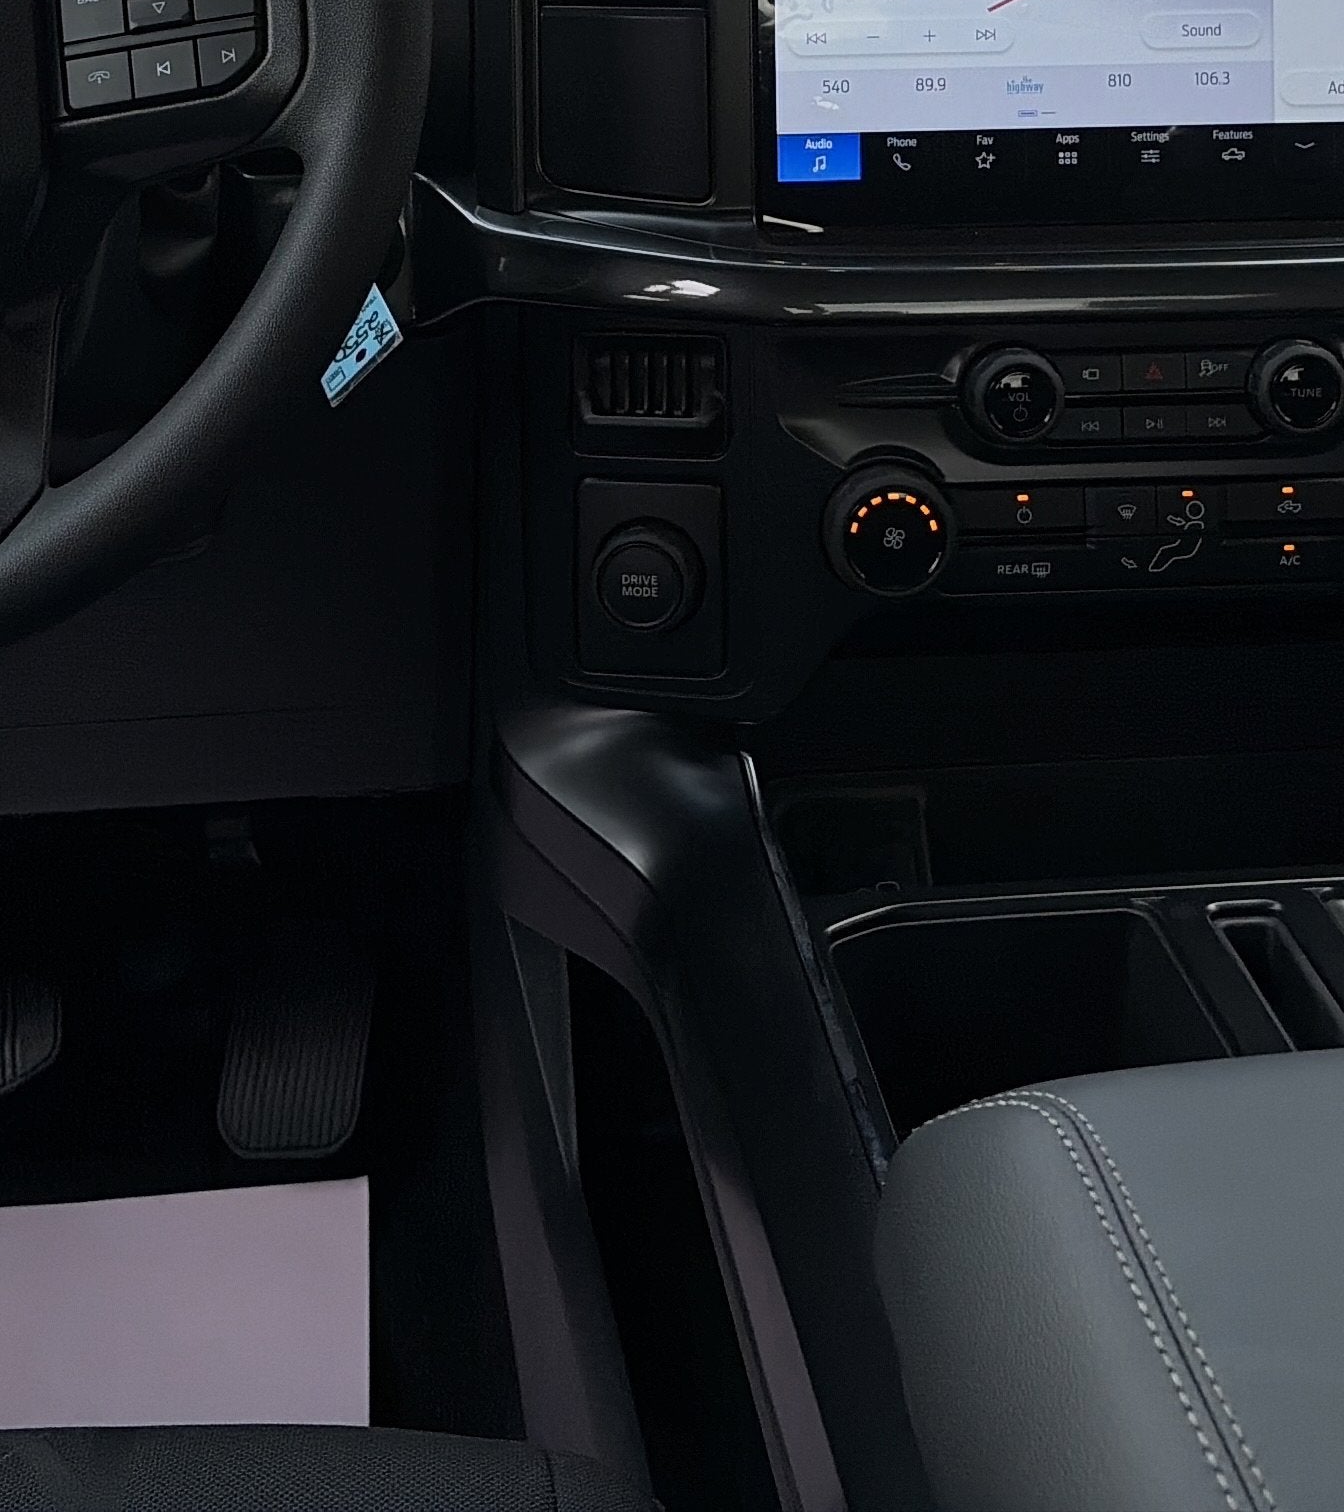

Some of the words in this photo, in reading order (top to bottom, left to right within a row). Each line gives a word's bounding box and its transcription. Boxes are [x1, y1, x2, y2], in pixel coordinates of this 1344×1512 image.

[1181, 22, 1222, 38] Sound
[915, 77, 946, 92] 89.9
[1108, 73, 1132, 88] 810
[1194, 71, 1231, 86] 106.3
[822, 79, 850, 94] 540
[976, 134, 994, 147] Fav
[1055, 133, 1080, 146] Apps
[1130, 130, 1170, 144] Settings
[1212, 128, 1254, 141] Features
[805, 137, 833, 150] Audio
[886, 136, 917, 149] Phone
[1007, 392, 1032, 404] VOL
[1290, 387, 1323, 399] TUNE
[1279, 555, 1301, 567] A/C
[996, 564, 1030, 576] REAR
[621, 574, 659, 586] DRIVE
[621, 586, 659, 598] MODE
